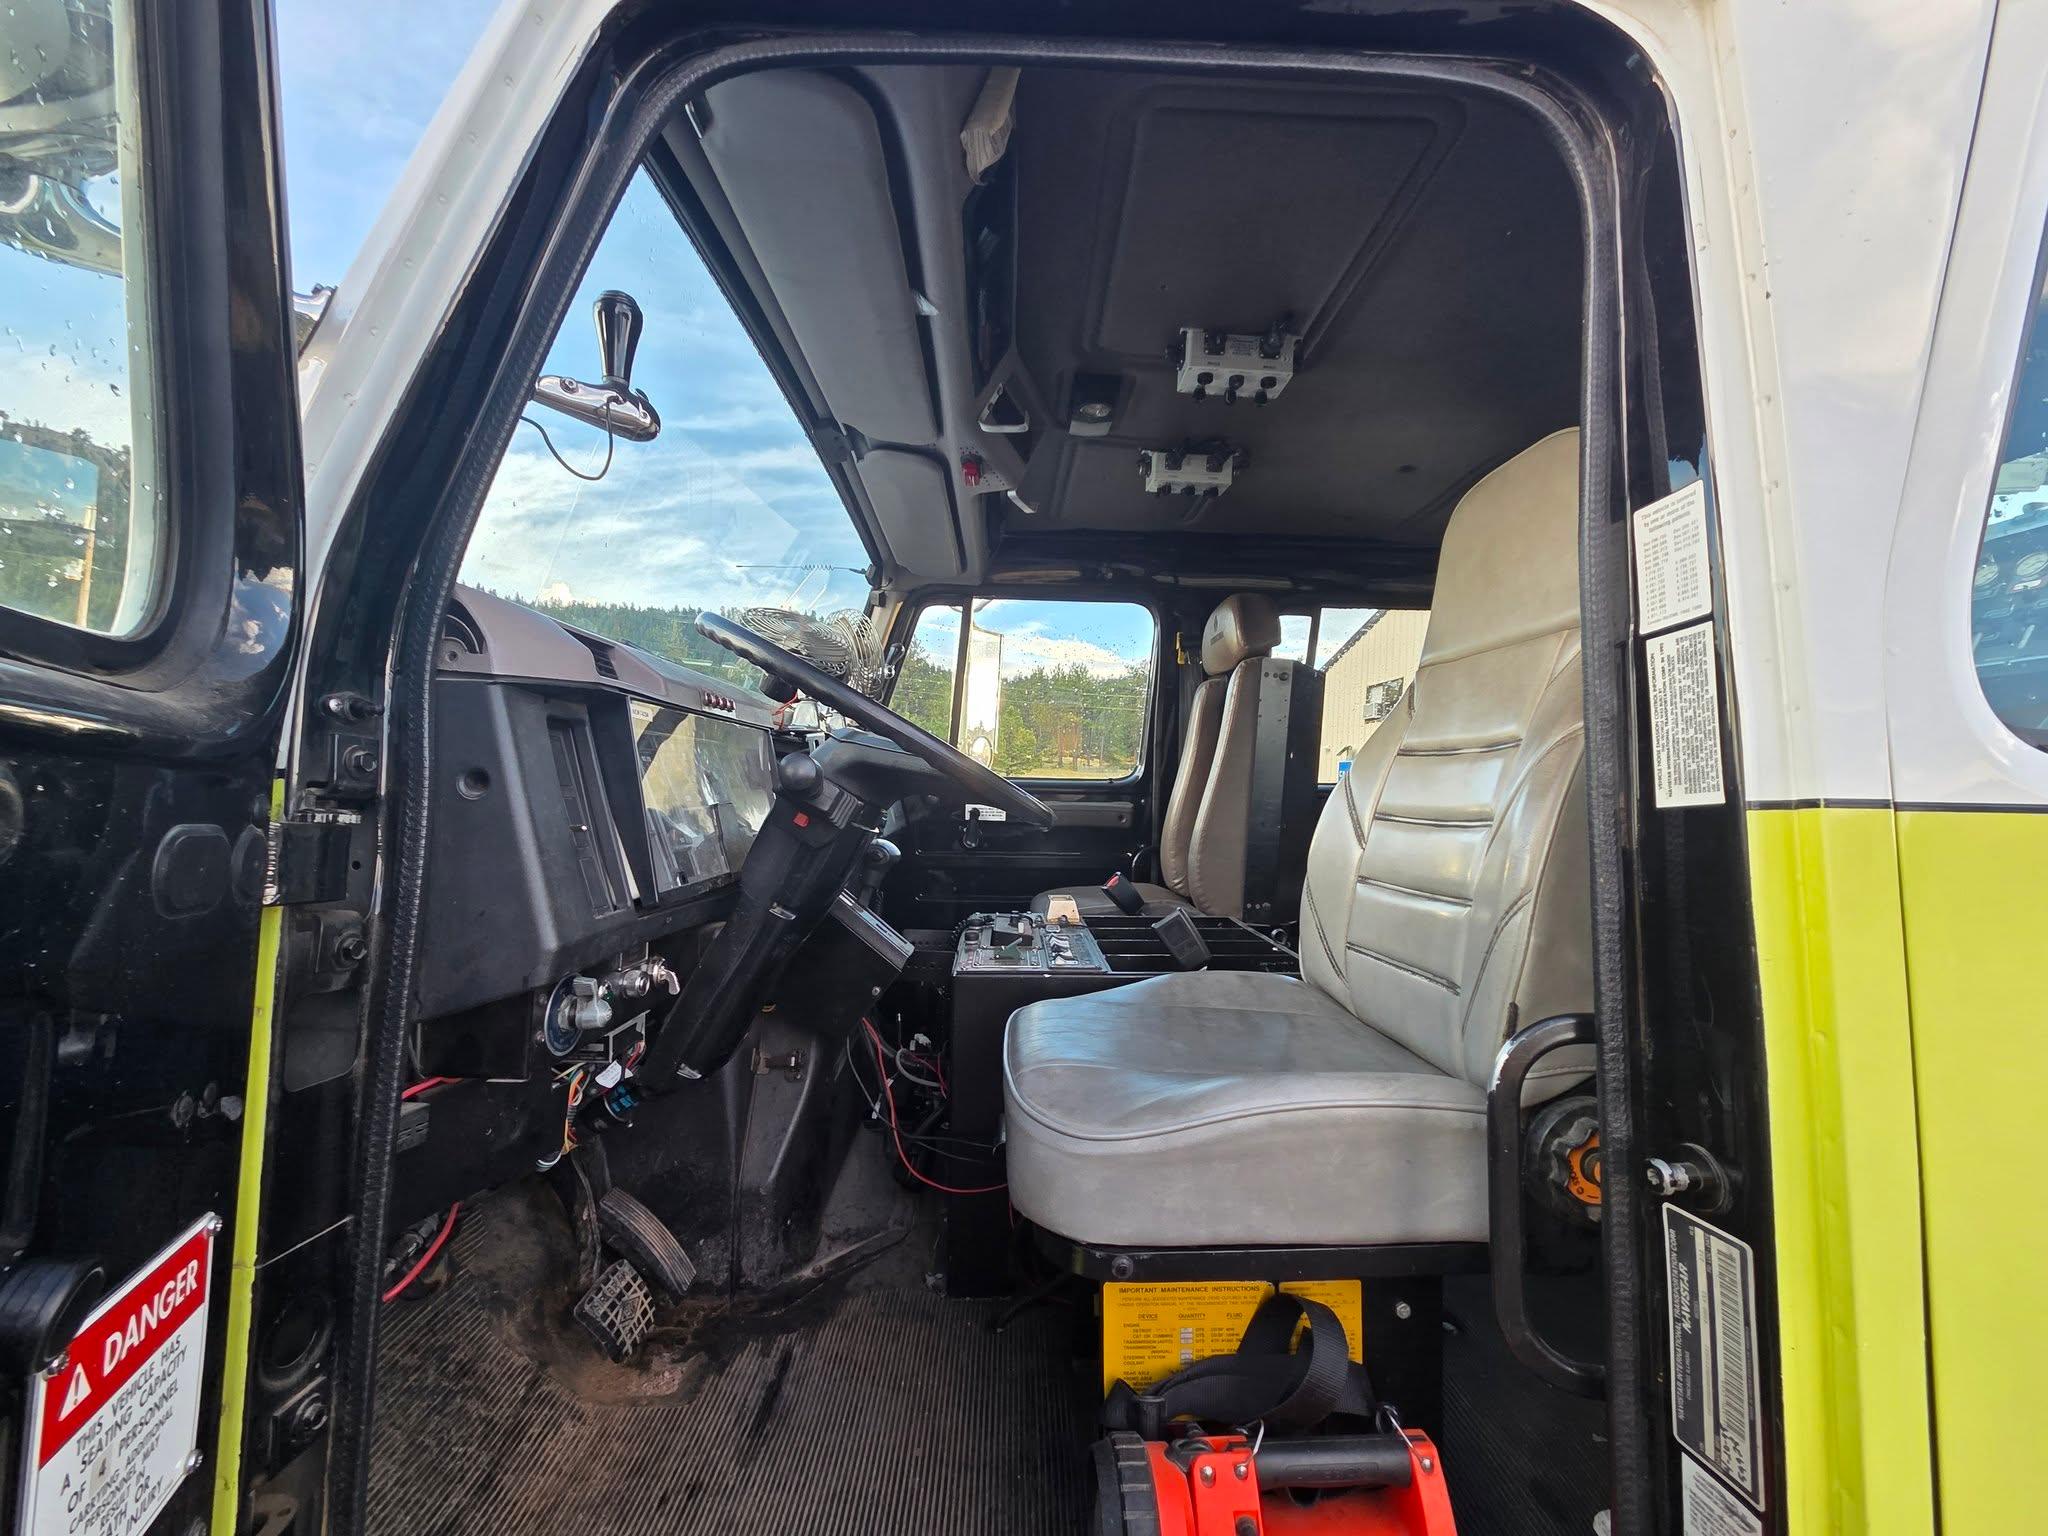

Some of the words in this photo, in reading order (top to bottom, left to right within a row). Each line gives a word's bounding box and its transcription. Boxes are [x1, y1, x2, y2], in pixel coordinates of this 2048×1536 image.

[104, 1260, 197, 1377] DANGER
[1678, 1263, 1690, 1332] NAVISTAR
[60, 1473, 70, 1495] A
[80, 1405, 132, 1473] SEATING
[139, 1346, 186, 1406] CAPACITY
[76, 1416, 102, 1455] THIS
[112, 1362, 153, 1415] VEHICLE
[160, 1334, 180, 1365] HAS
[67, 1481, 85, 1513] OF
[118, 1380, 177, 1455] PERSONNEL
[134, 1475, 150, 1503] OR
[84, 1464, 135, 1533] PERSONNEL
[125, 1477, 162, 1536] INJURY
